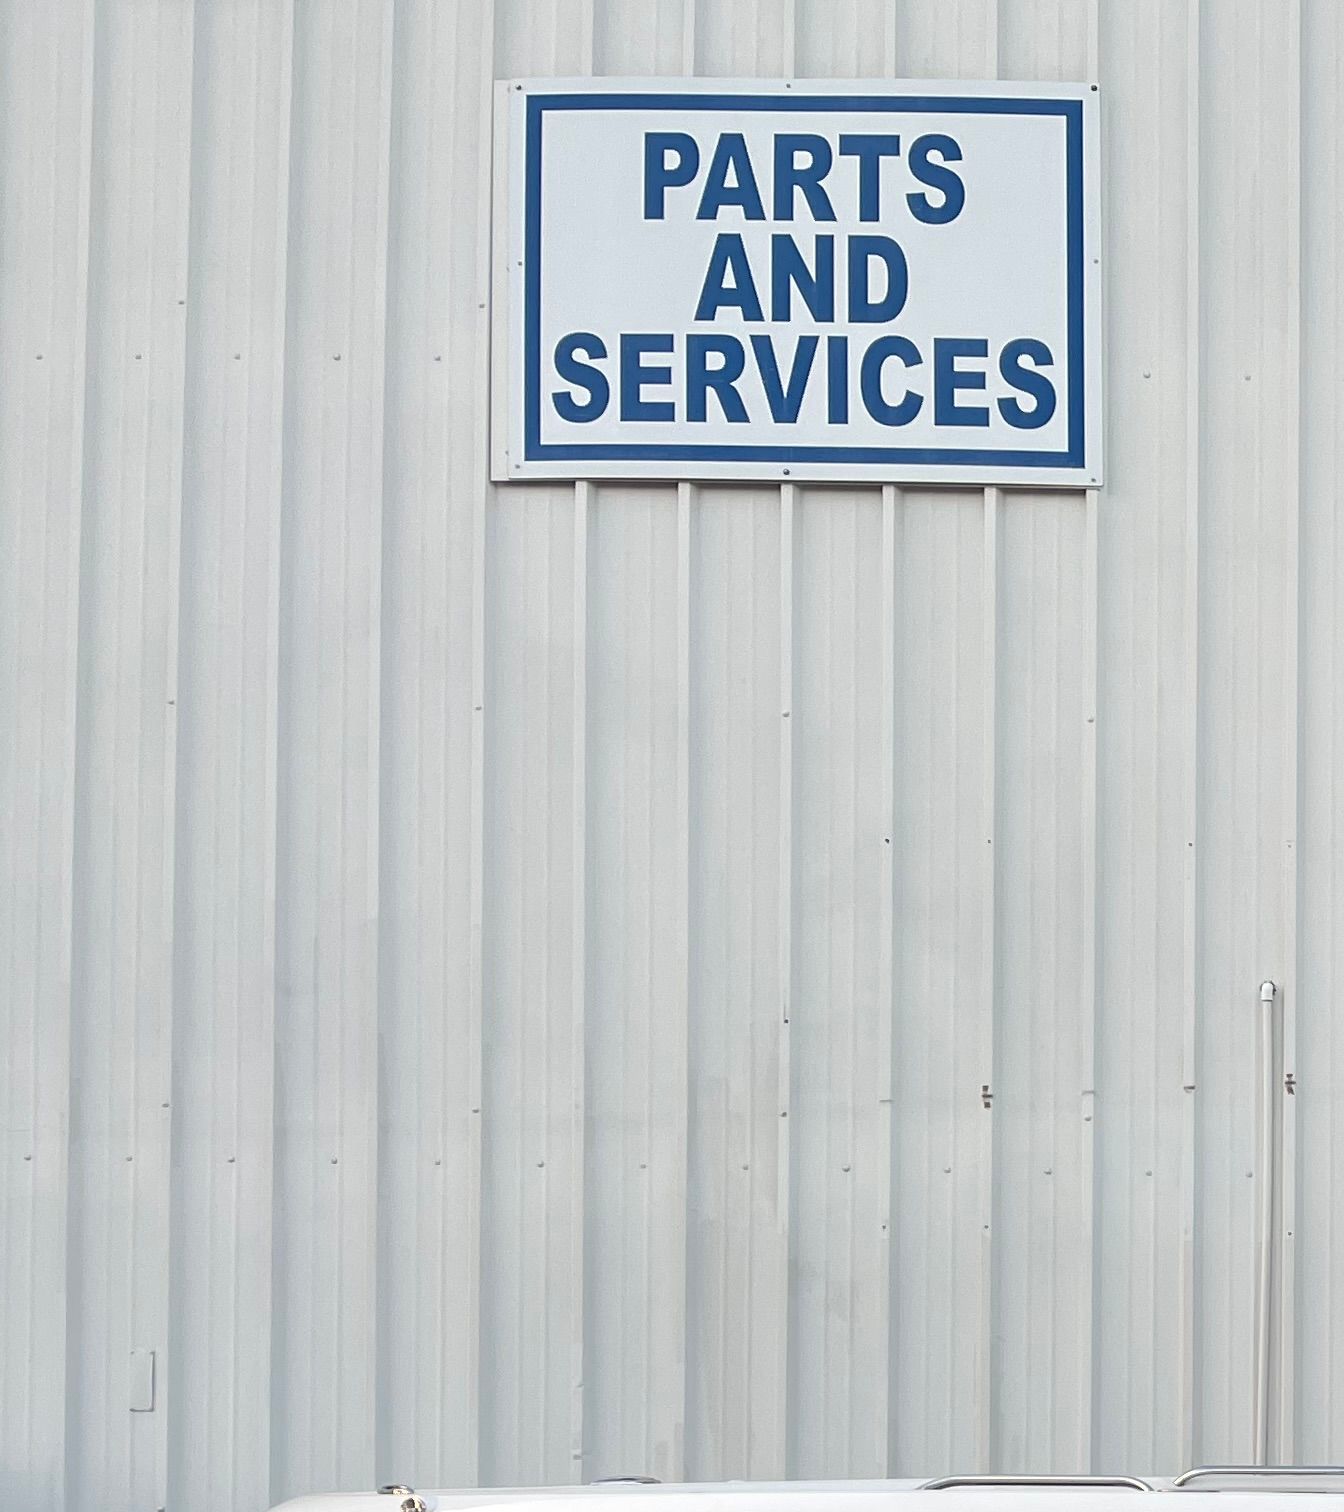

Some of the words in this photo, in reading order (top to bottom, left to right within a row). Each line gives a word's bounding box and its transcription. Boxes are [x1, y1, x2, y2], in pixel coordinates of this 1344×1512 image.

[643, 131, 966, 225] PARTS
[694, 232, 909, 323] AND
[551, 331, 1057, 430] SERVICES
